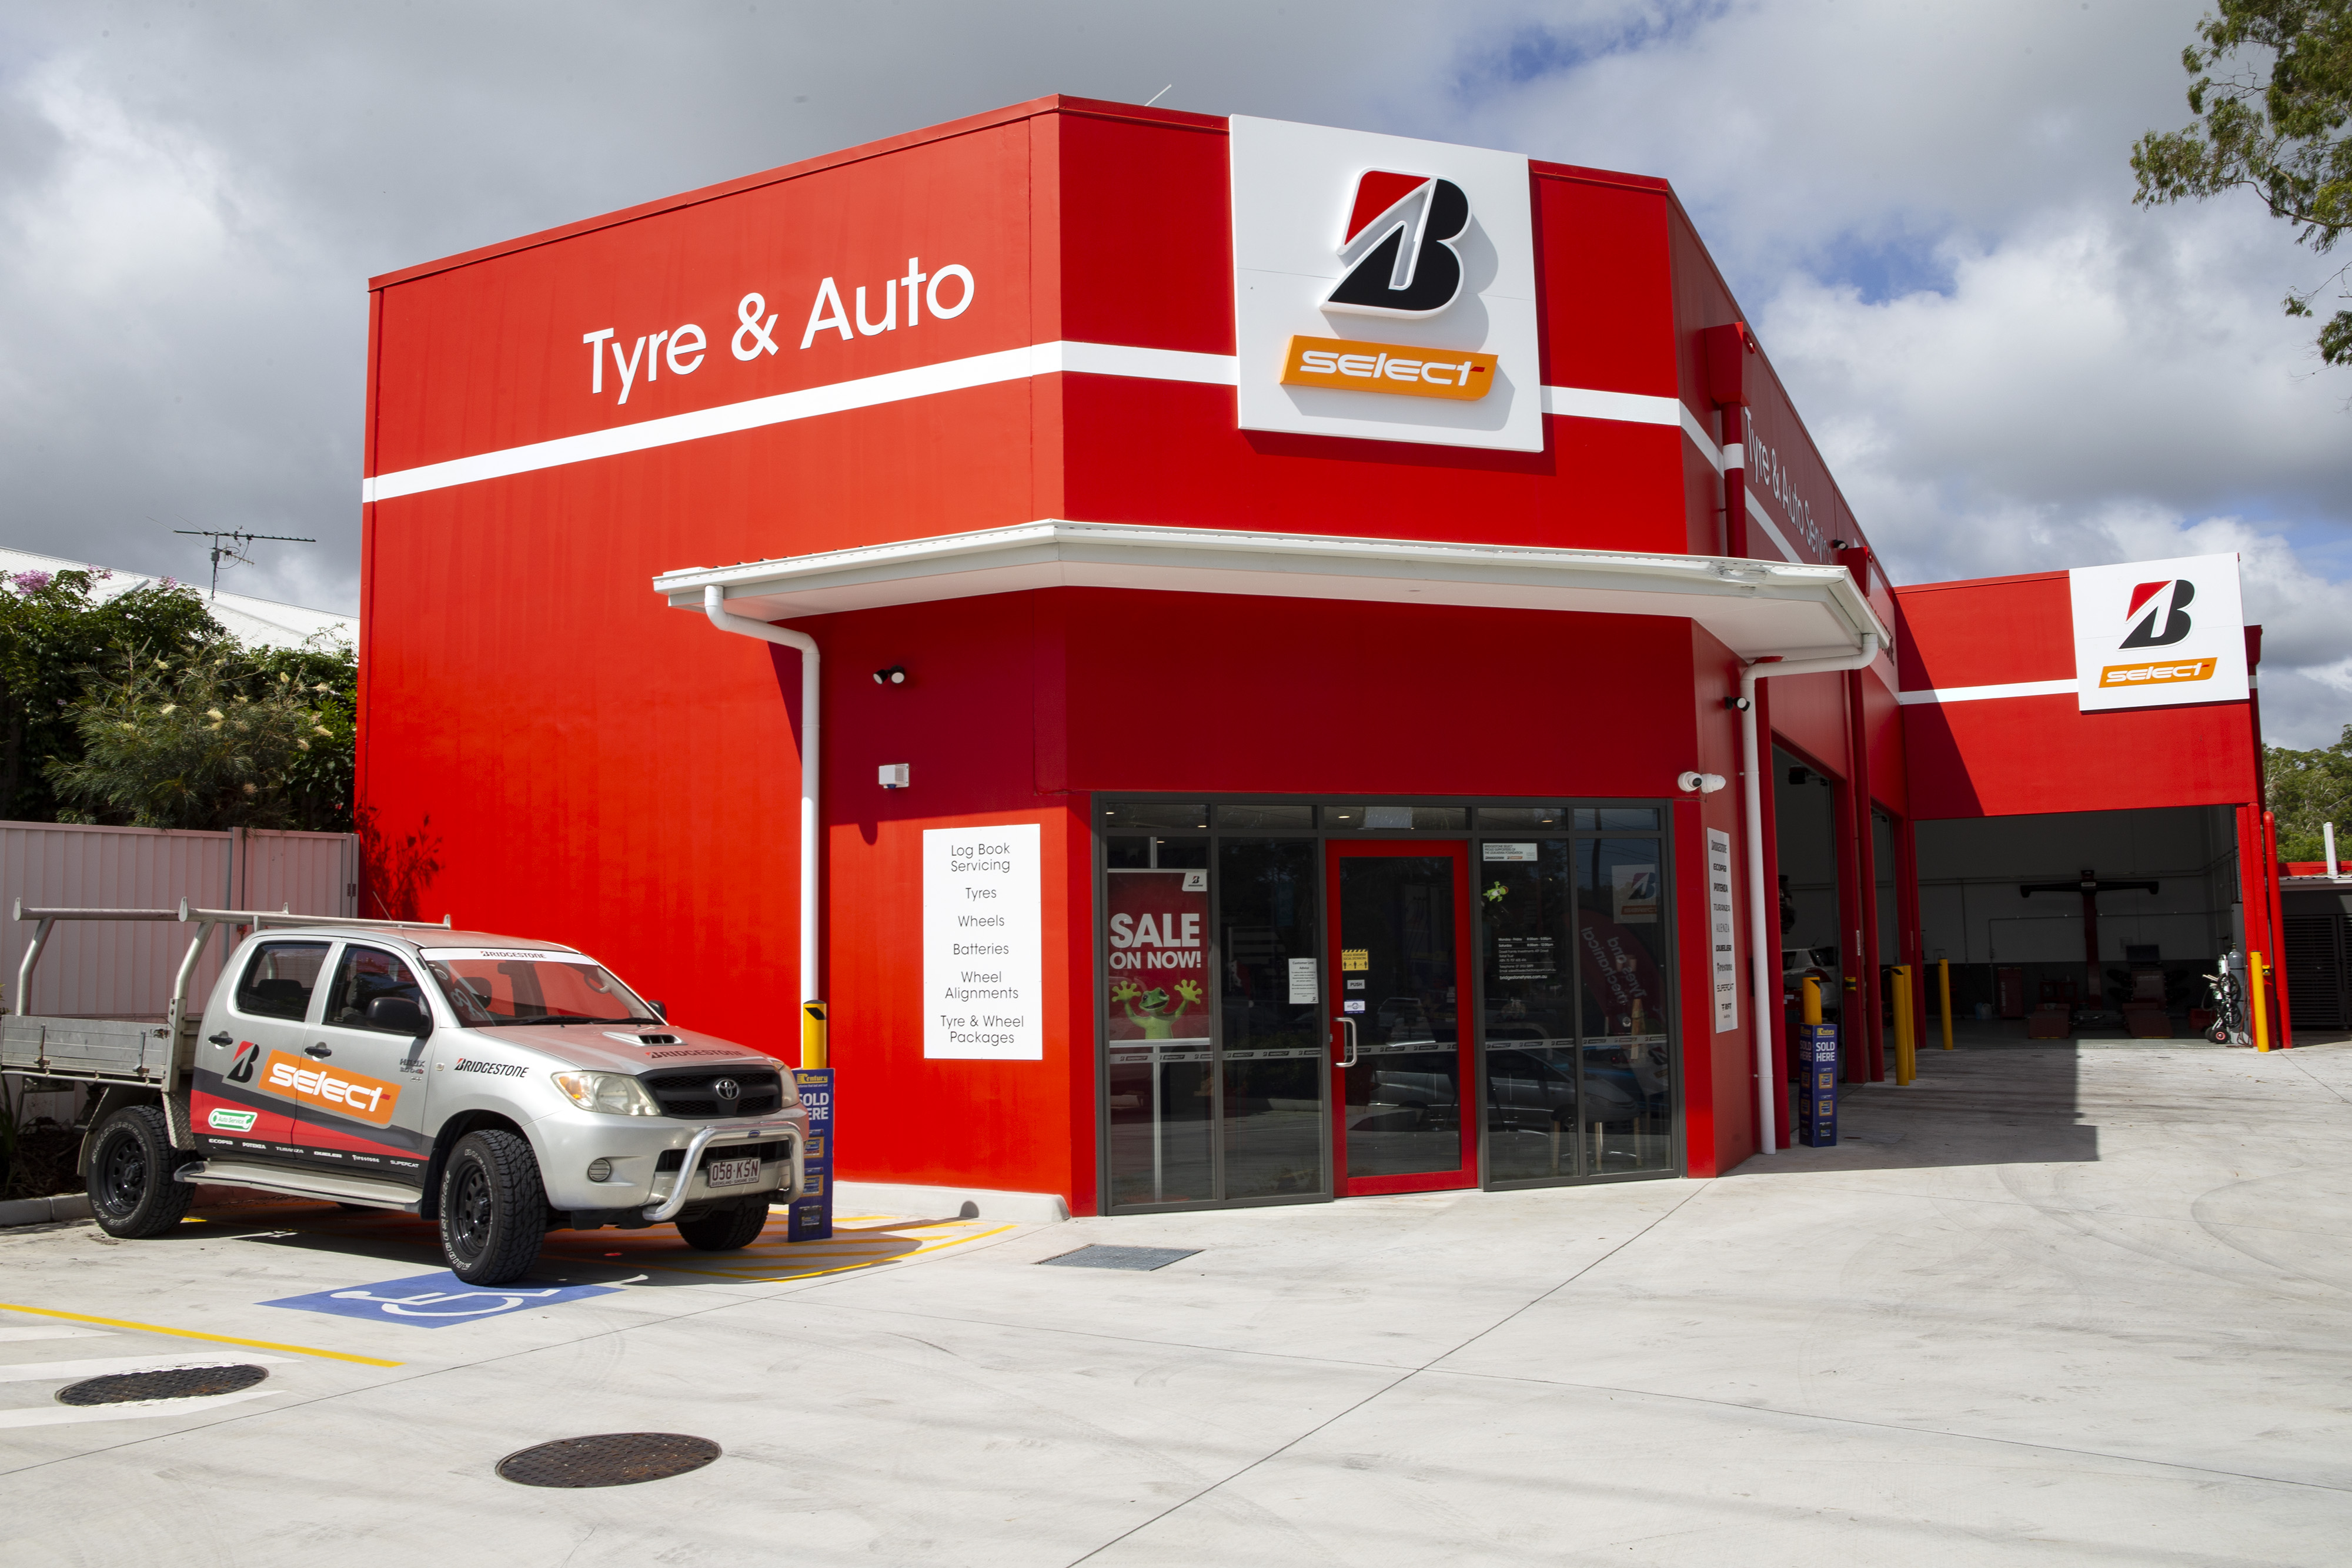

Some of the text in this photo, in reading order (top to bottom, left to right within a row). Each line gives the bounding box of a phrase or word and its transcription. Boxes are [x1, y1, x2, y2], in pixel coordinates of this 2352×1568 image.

[583, 257, 974, 405] Tyre & Auto
[1745, 406, 1769, 484] Tyre
[1771, 447, 1781, 503] &
[1782, 466, 1804, 536] Auto
[951, 842, 1010, 858] Log Book
[951, 859, 1010, 873] Servicing
[965, 887, 997, 901] Tyres
[1713, 904, 1730, 912] TURANZA
[958, 915, 1004, 927] Wheels
[1716, 923, 1730, 932] ALENZA
[1110, 913, 1200, 948] SALE
[480, 951, 547, 959] BRIDGESTONE
[953, 943, 1009, 955] Batteries
[1110, 951, 1201, 969] ON NOW!
[961, 971, 1001, 982] Wheel
[945, 987, 1018, 1002] Alignments
[941, 1015, 1024, 1029] Tyre & Wheel
[950, 1031, 1014, 1047] Packages
[1816, 1041, 1835, 1051] SOLD
[645, 1050, 747, 1058] BRIDGESTONE
[1816, 1052, 1835, 1062] HERE
[454, 1058, 530, 1078] BRIDGESTONE
[807, 1107, 828, 1120] ERE
[352, 1154, 380, 1163] Firestone
